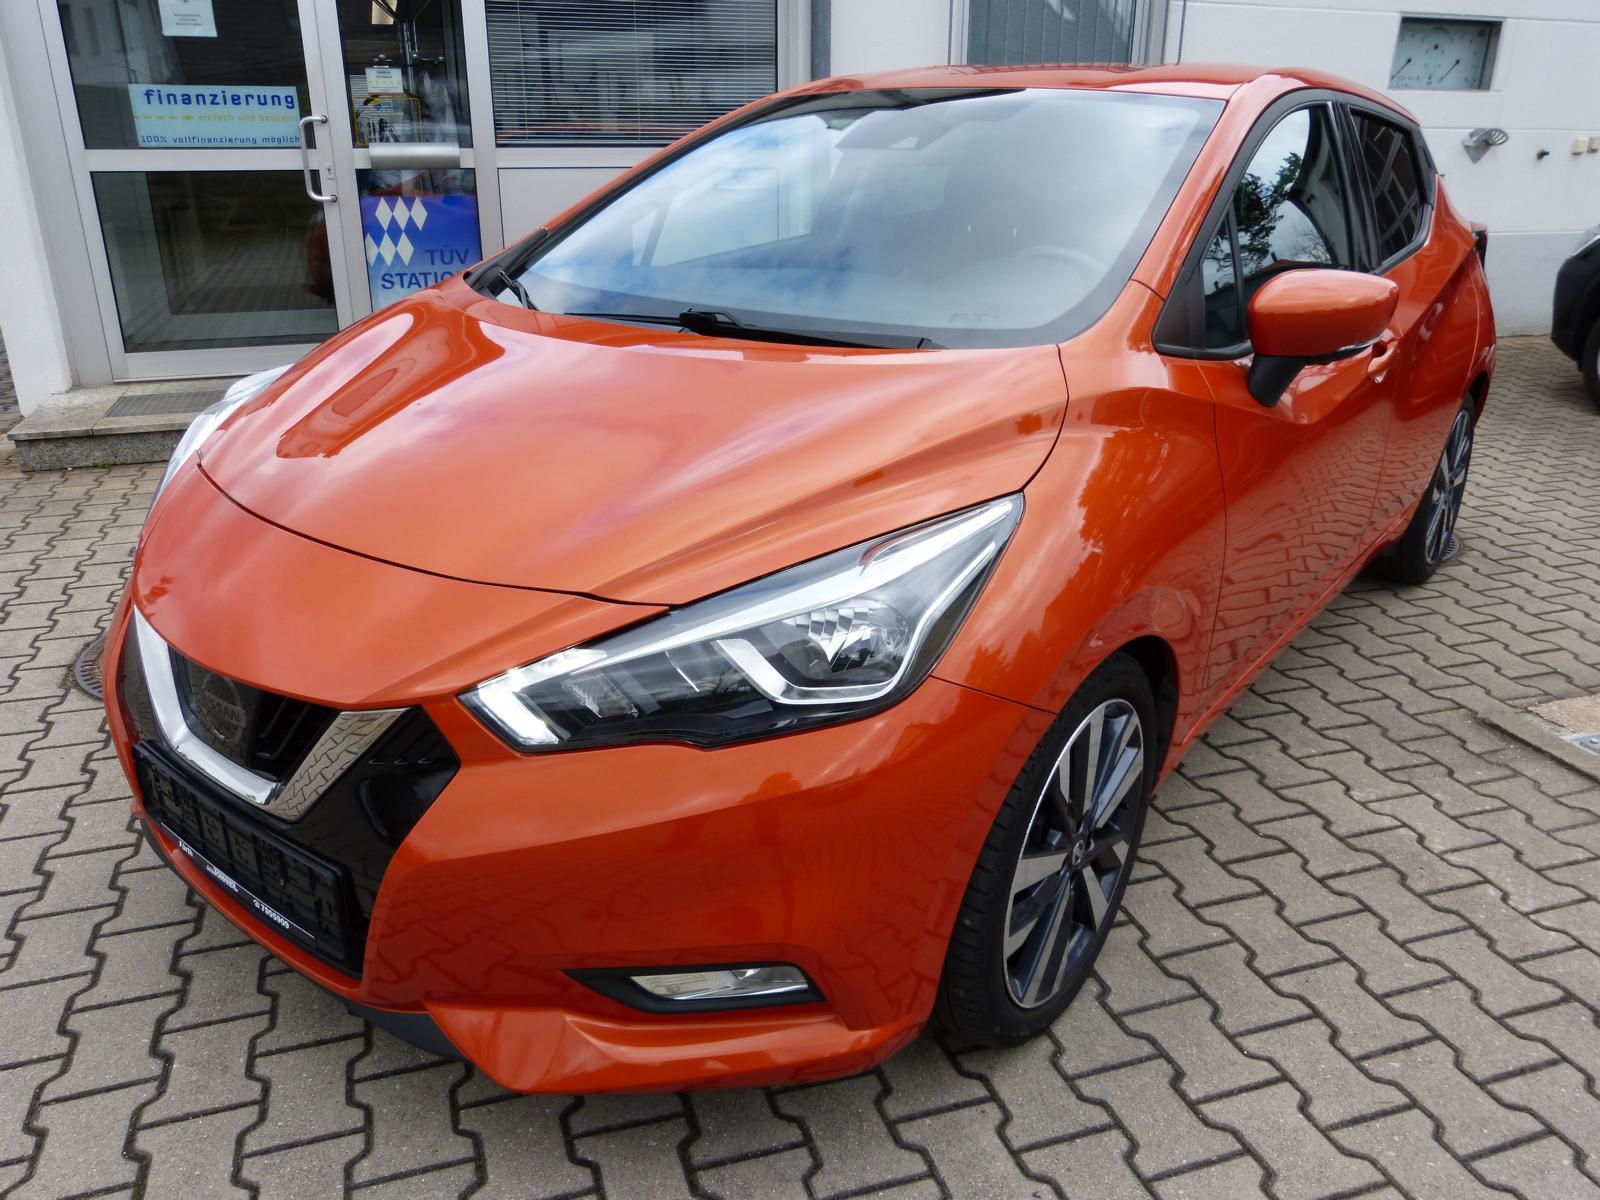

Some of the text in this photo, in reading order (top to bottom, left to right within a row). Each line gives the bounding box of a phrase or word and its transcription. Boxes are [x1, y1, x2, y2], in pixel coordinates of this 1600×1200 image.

[144, 90, 295, 109] finanzierung
[141, 136, 300, 145] 100% vollfinanzierung möglich
[425, 244, 469, 266] TÜV
[381, 271, 459, 290] STATIO
